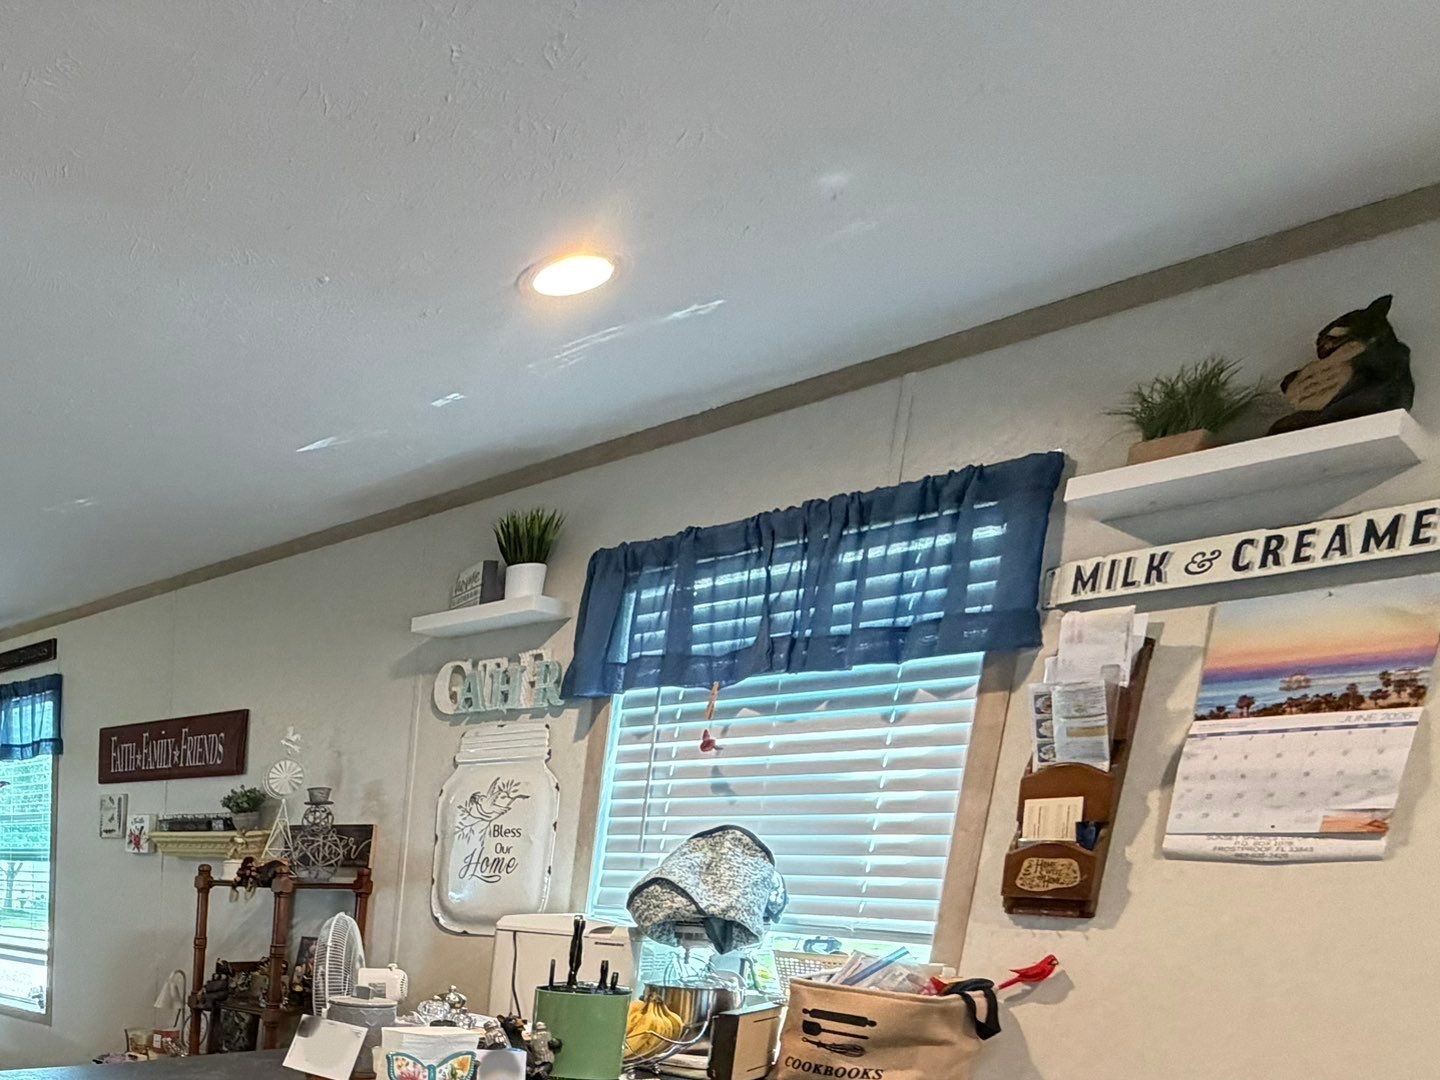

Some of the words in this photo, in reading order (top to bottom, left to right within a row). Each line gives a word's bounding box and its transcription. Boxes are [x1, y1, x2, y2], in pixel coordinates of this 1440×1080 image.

[1071, 551, 1171, 595] MILK
[1184, 549, 1222, 575] &
[1231, 507, 1438, 572] CREAME
[433, 648, 565, 715] GATHER
[110, 736, 137, 773] FAITH
[179, 728, 225, 767] FRIENDS
[492, 824, 522, 838] Bless
[494, 842, 513, 855] Our
[458, 847, 519, 883] Home
[784, 1056, 884, 1080] COOKBOOKS
